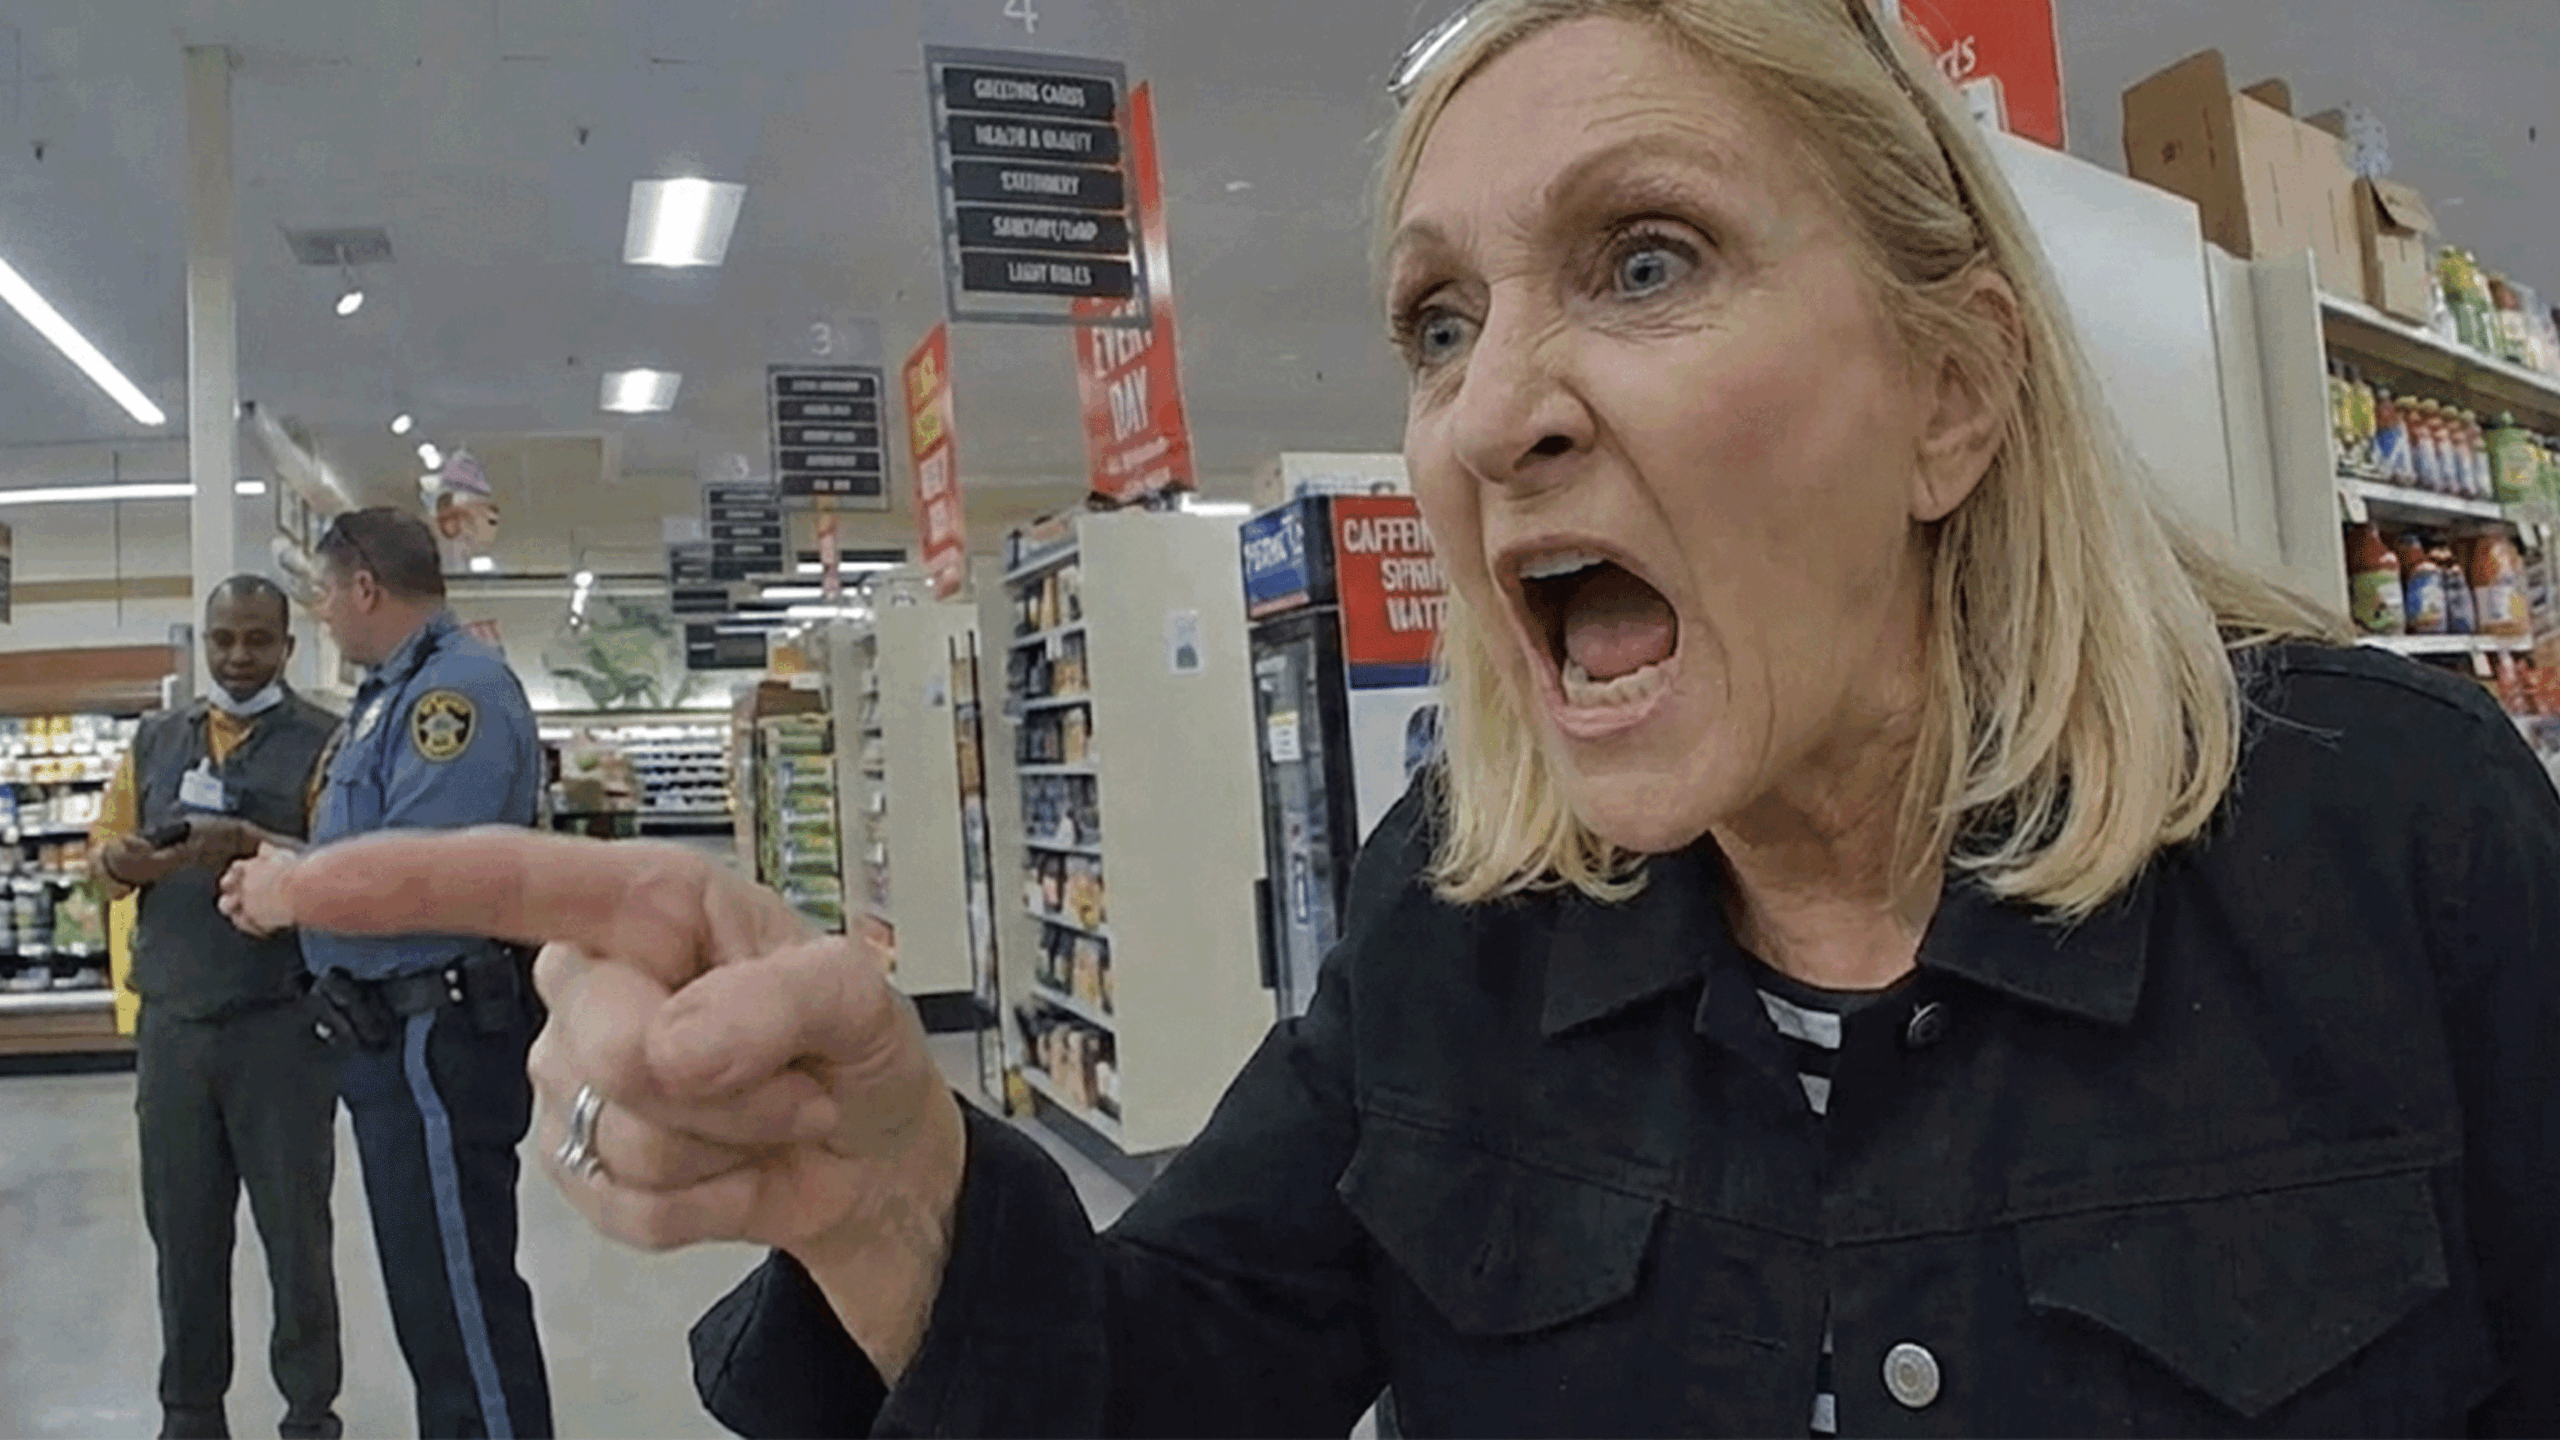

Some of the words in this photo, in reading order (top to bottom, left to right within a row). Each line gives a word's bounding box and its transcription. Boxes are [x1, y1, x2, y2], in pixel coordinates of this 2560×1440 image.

[1002, 0, 1039, 33] 4
[810, 322, 832, 356] 3
[1108, 365, 1150, 442] DAY
[1343, 515, 1436, 554] CAFFEIN
